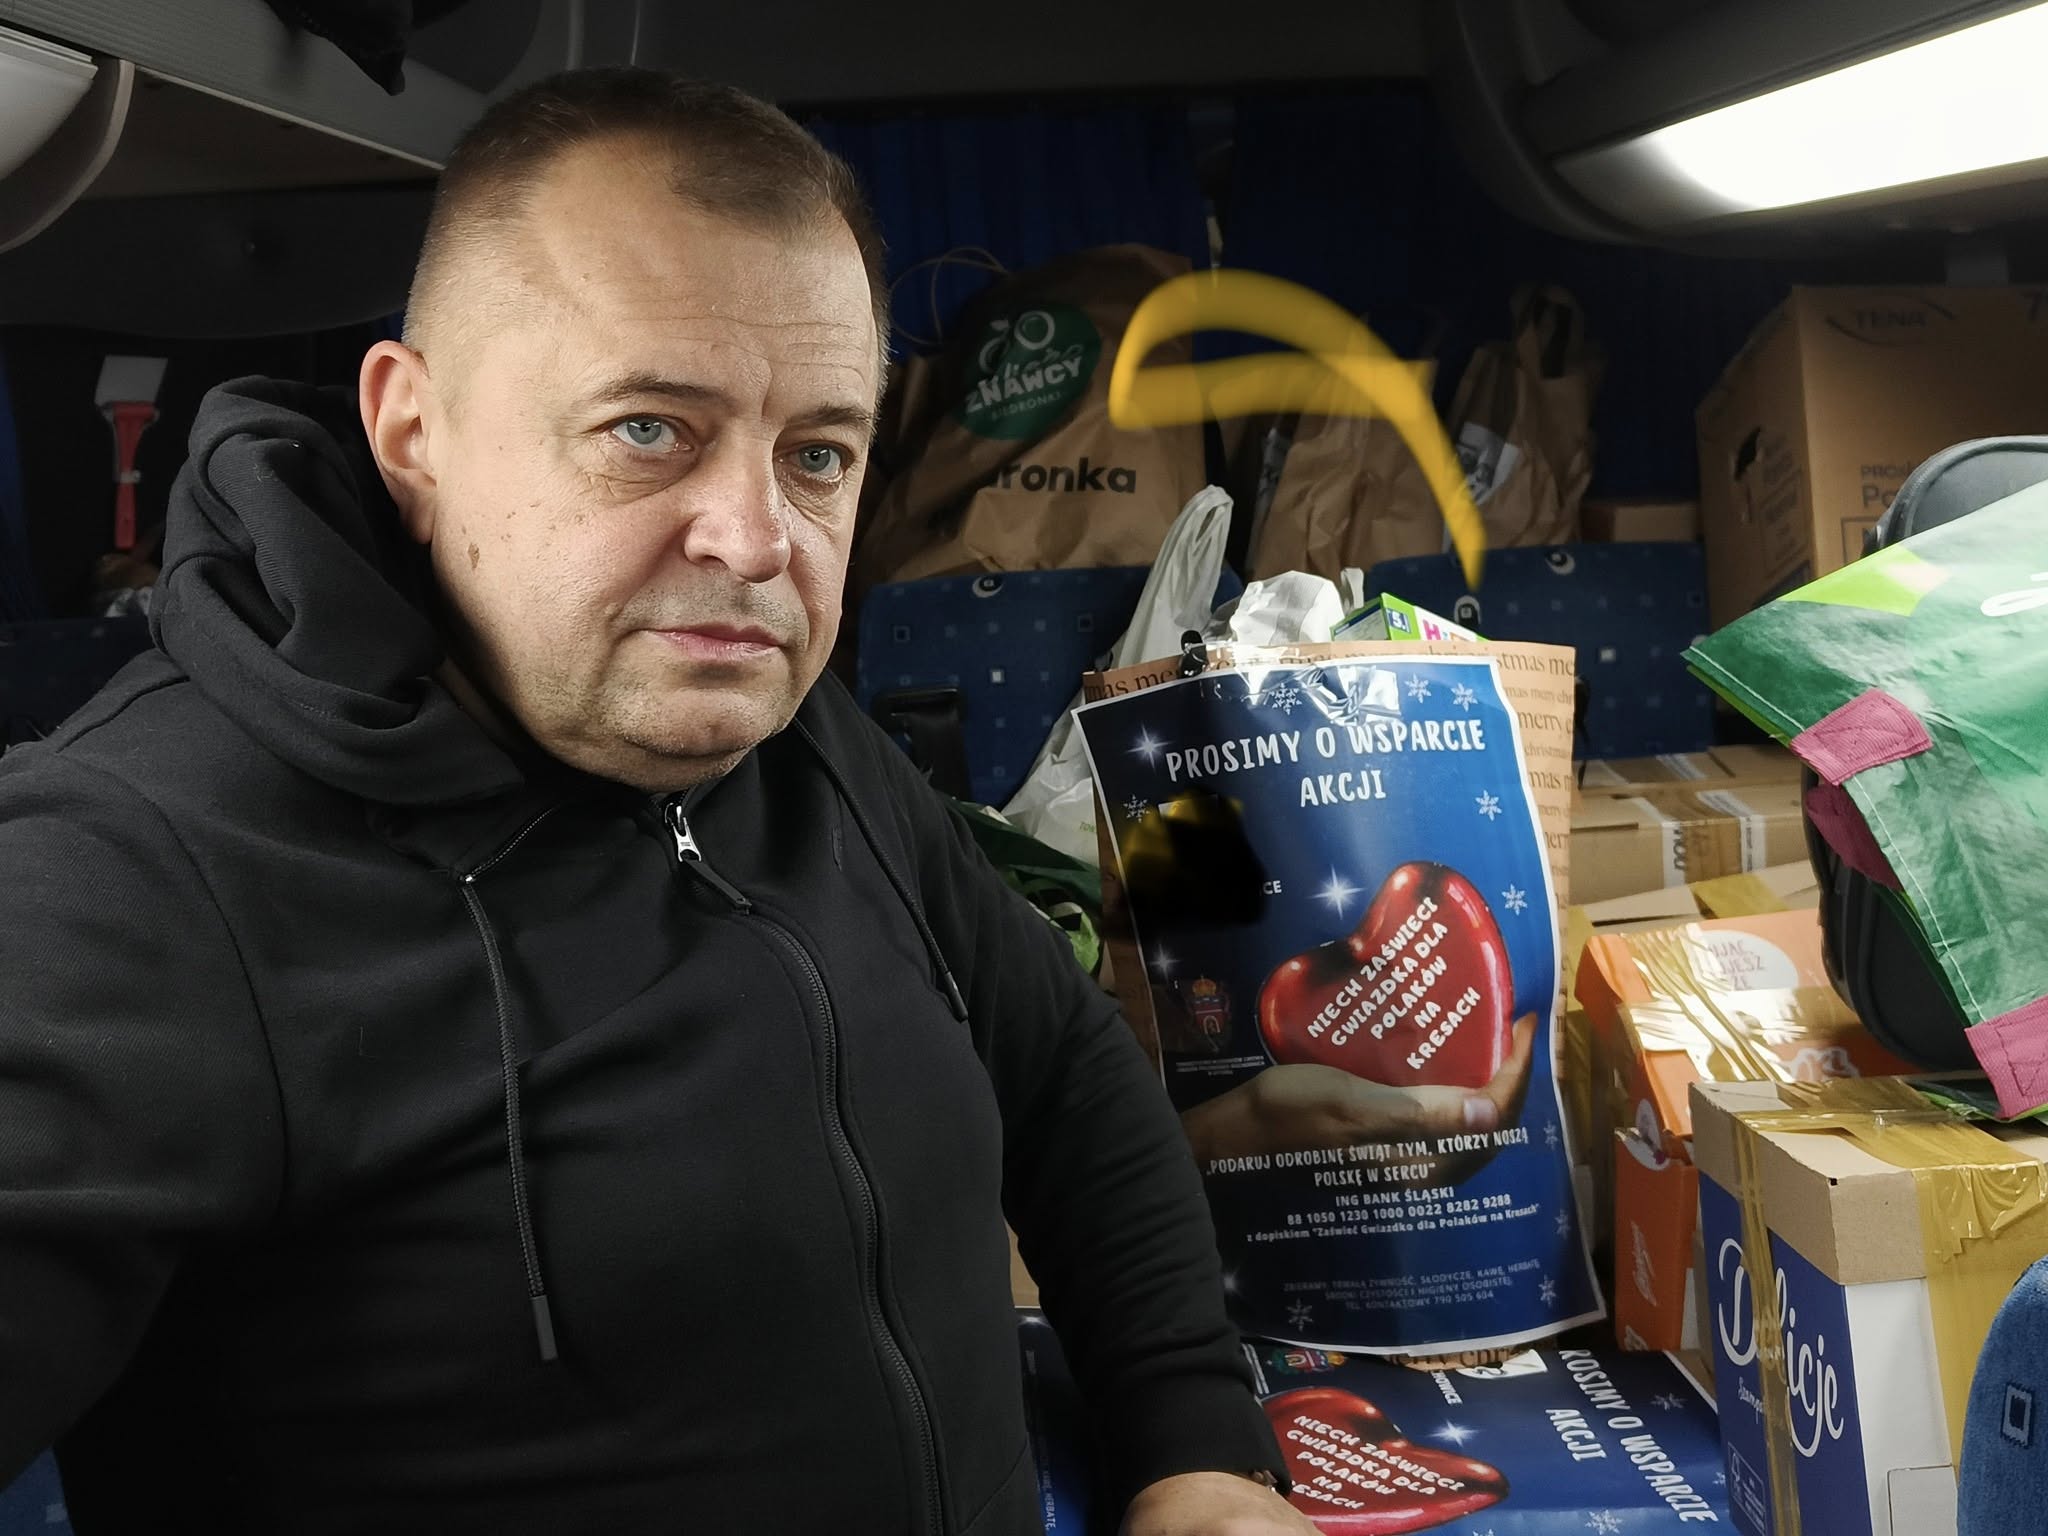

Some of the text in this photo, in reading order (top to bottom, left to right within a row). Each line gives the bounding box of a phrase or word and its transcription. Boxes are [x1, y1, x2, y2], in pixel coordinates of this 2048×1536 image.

[1165, 718, 1487, 782] PROSIMY O WSPARCIE
[1300, 769, 1387, 807] AKCJI
[1307, 896, 1439, 1039] NIECH ZAŚWIECI
[1331, 922, 1449, 1046] GWIAZDKA DLA
[1370, 955, 1447, 1040] POLAKÓW
[1414, 1001, 1442, 1029] NA
[1406, 986, 1481, 1070] KRESACH
[1275, 1147, 1345, 1169] ODROBINĘ
[1349, 1143, 1392, 1163] ŚWIĄT
[1437, 1133, 1489, 1155] KTÓRZY
[1493, 1126, 1530, 1146] NOSZĄ
[1314, 1168, 1363, 1187] POLSKĘ
[1367, 1167, 1379, 1183] W
[1335, 1186, 1455, 1207] ING BANK ŚLĄSKI
[1255, 1228, 1310, 1243] dopiskiem
[1417, 1219, 1437, 1230] dla
[1439, 1214, 1488, 1228] Polaków
[1490, 1212, 1503, 1222] na
[1287, 1214, 1303, 1226] 88
[1306, 1212, 1336, 1224] 1050
[1340, 1208, 1369, 1222] 1230
[1373, 1207, 1404, 1219] 1000
[1407, 1203, 1443, 1217] 0022
[1446, 1199, 1480, 1214] 8282
[1718, 1237, 1844, 1458] Dlicje
[1545, 1408, 1608, 1462] AKCJI
[1607, 1416, 1644, 1430] O
[1286, 1429, 1437, 1496] GWIAZDKA DLA
[1293, 1415, 1466, 1492] NIECH ZAŚWIECI
[1296, 1451, 1397, 1496] POLAKÓW
[1620, 1433, 1719, 1522] WSPARCIE
[1312, 1475, 1343, 1493] NA
